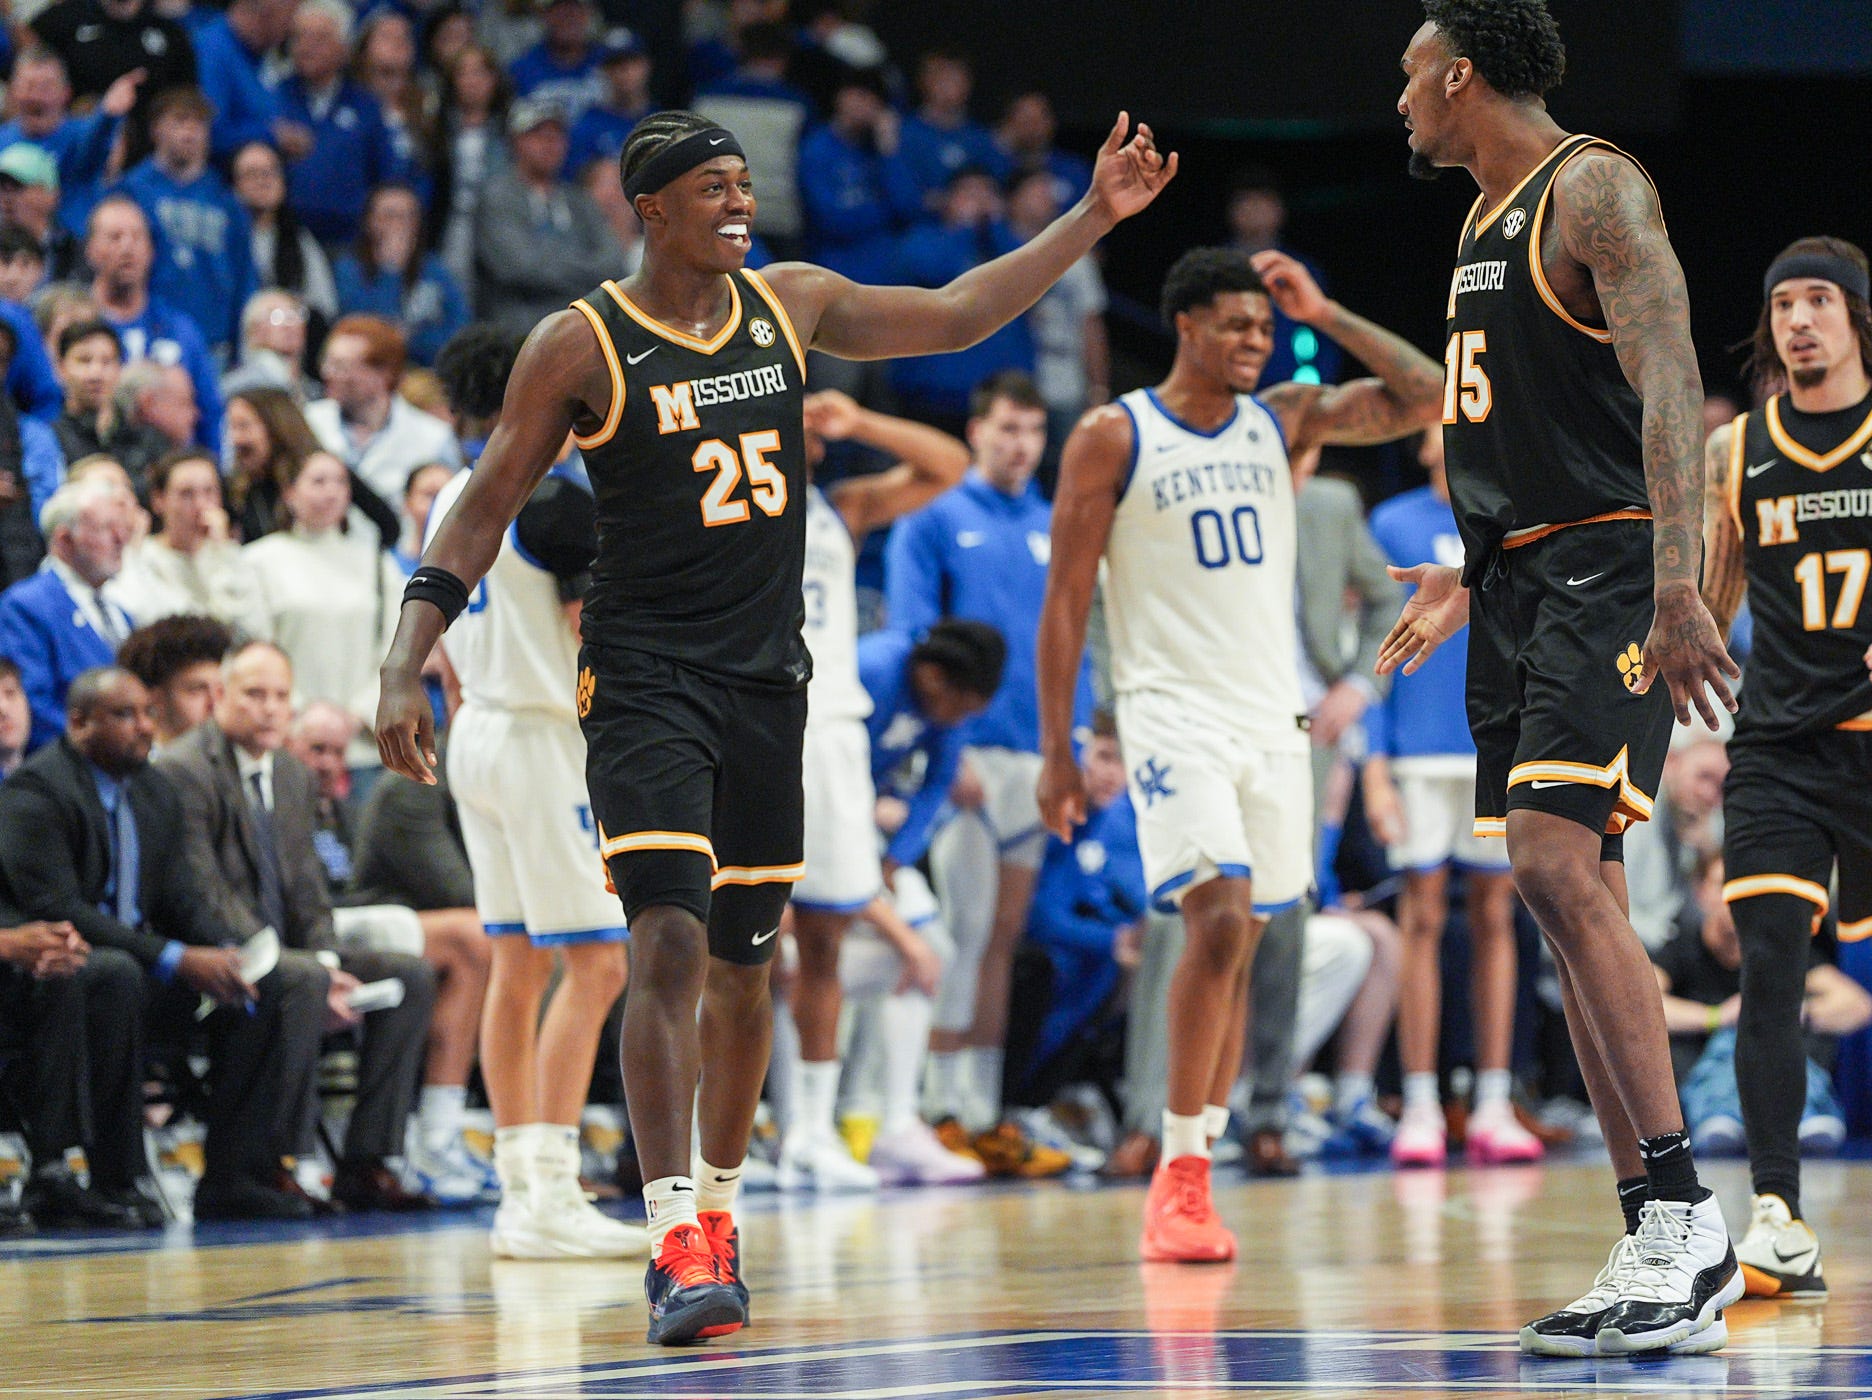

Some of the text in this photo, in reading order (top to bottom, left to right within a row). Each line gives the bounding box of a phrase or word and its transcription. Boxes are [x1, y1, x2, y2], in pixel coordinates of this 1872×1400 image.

[1504, 210, 1524, 237] SEC
[751, 319, 774, 345] SEC
[650, 364, 787, 434] MISSOURI
[1442, 330, 1492, 424] 15
[691, 429, 788, 527] 25
[1152, 461, 1276, 511] KENTUCKY
[1191, 505, 1263, 569] 00
[1794, 548, 1872, 631] 17
